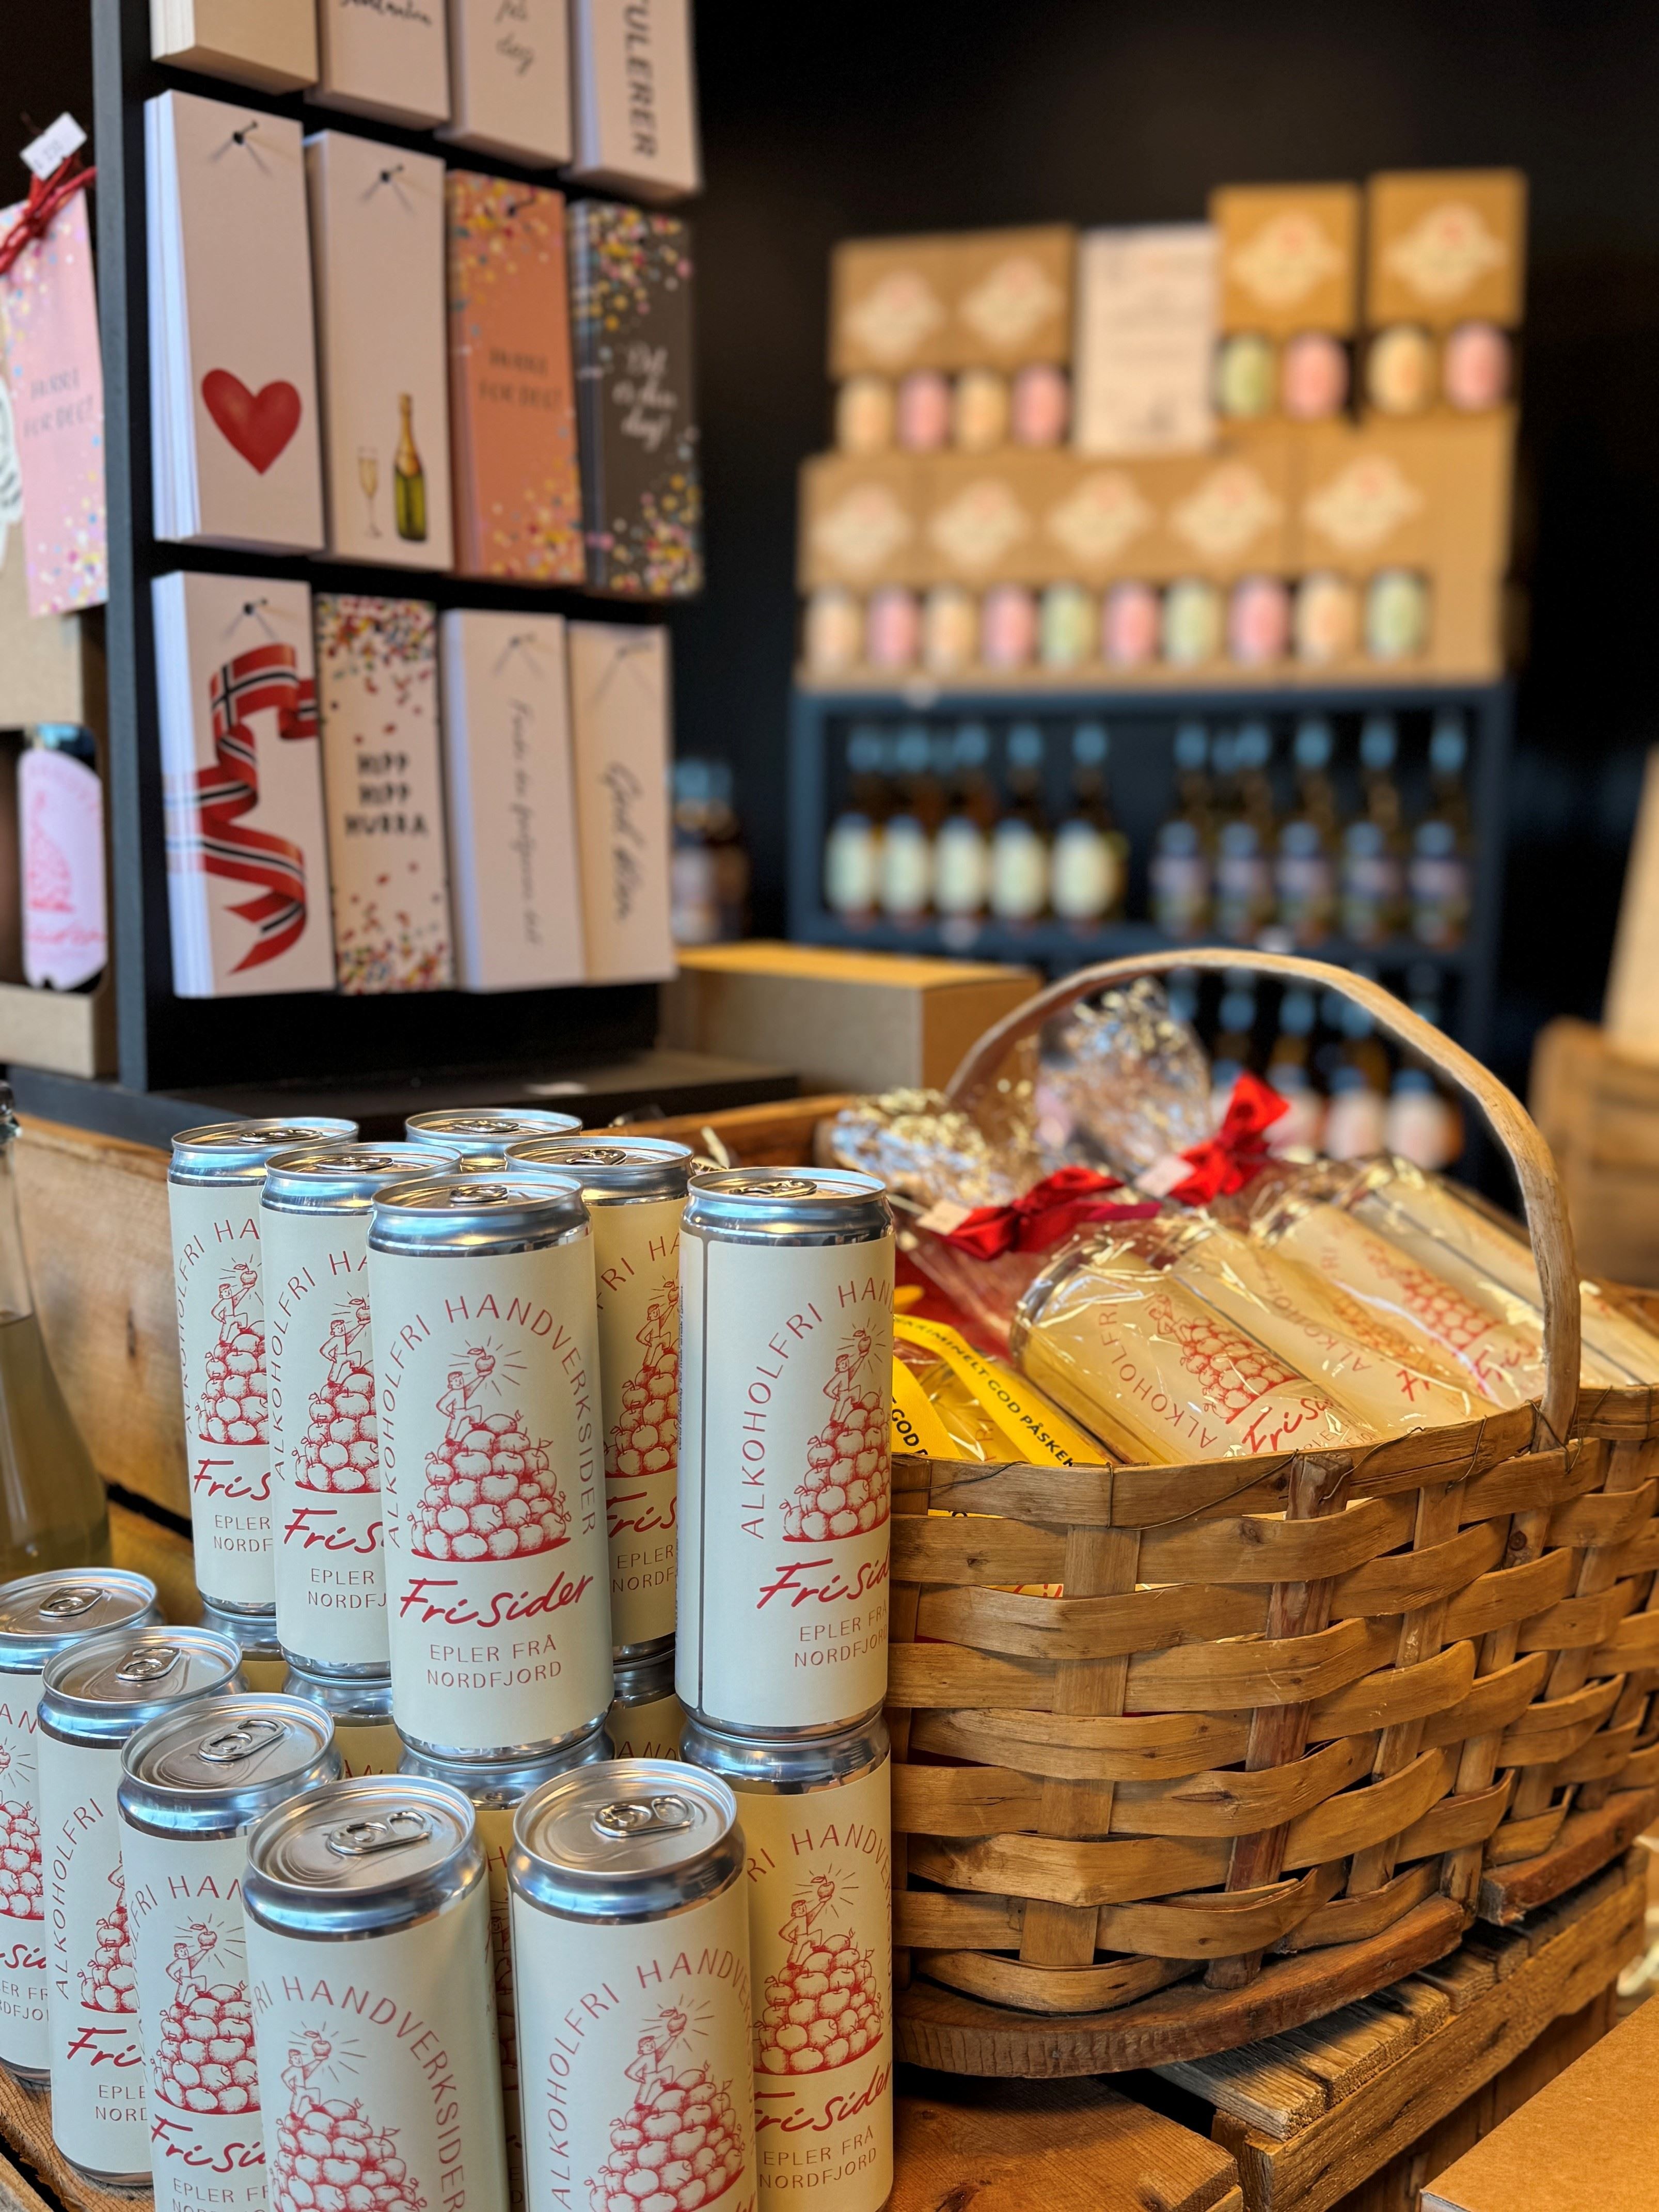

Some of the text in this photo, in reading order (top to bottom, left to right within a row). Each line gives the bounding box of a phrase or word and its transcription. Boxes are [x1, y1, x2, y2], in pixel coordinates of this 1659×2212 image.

[624, 0, 658, 157] ULERER
[271, 1267, 316, 1481] ALKOHOLFRI
[987, 1379, 1021, 1414] GOD
[382, 1314, 432, 1549] ALKOHOLFRI
[444, 1293, 596, 1535] HANDVERKSIDER
[740, 1302, 823, 1540] ALKOHOLFRI
[215, 1514, 271, 1530] EPLER
[214, 1536, 273, 1552] NORDF
[617, 1544, 673, 1570] EPLER
[310, 1568, 374, 1585] EPLER
[612, 1566, 674, 1593] NORDF
[308, 1591, 387, 1609] NORDFJ
[800, 1617, 861, 1642] EPLER
[430, 1634, 557, 1663] EPLER FRÅ
[794, 1624, 888, 1668] NORDFJORD
[426, 1661, 562, 1689] NORDFJORD
[52, 1798, 104, 2000] ALKOHOLFRI
[281, 1975, 467, 2212] HANDVERKSIDER
[547, 1982, 620, 2210] ALKOHOLFRI
[760, 2147, 877, 2189] NORDFJORD
[763, 2147, 831, 2166] EPLER
[173, 2177, 234, 2203] EPLER
